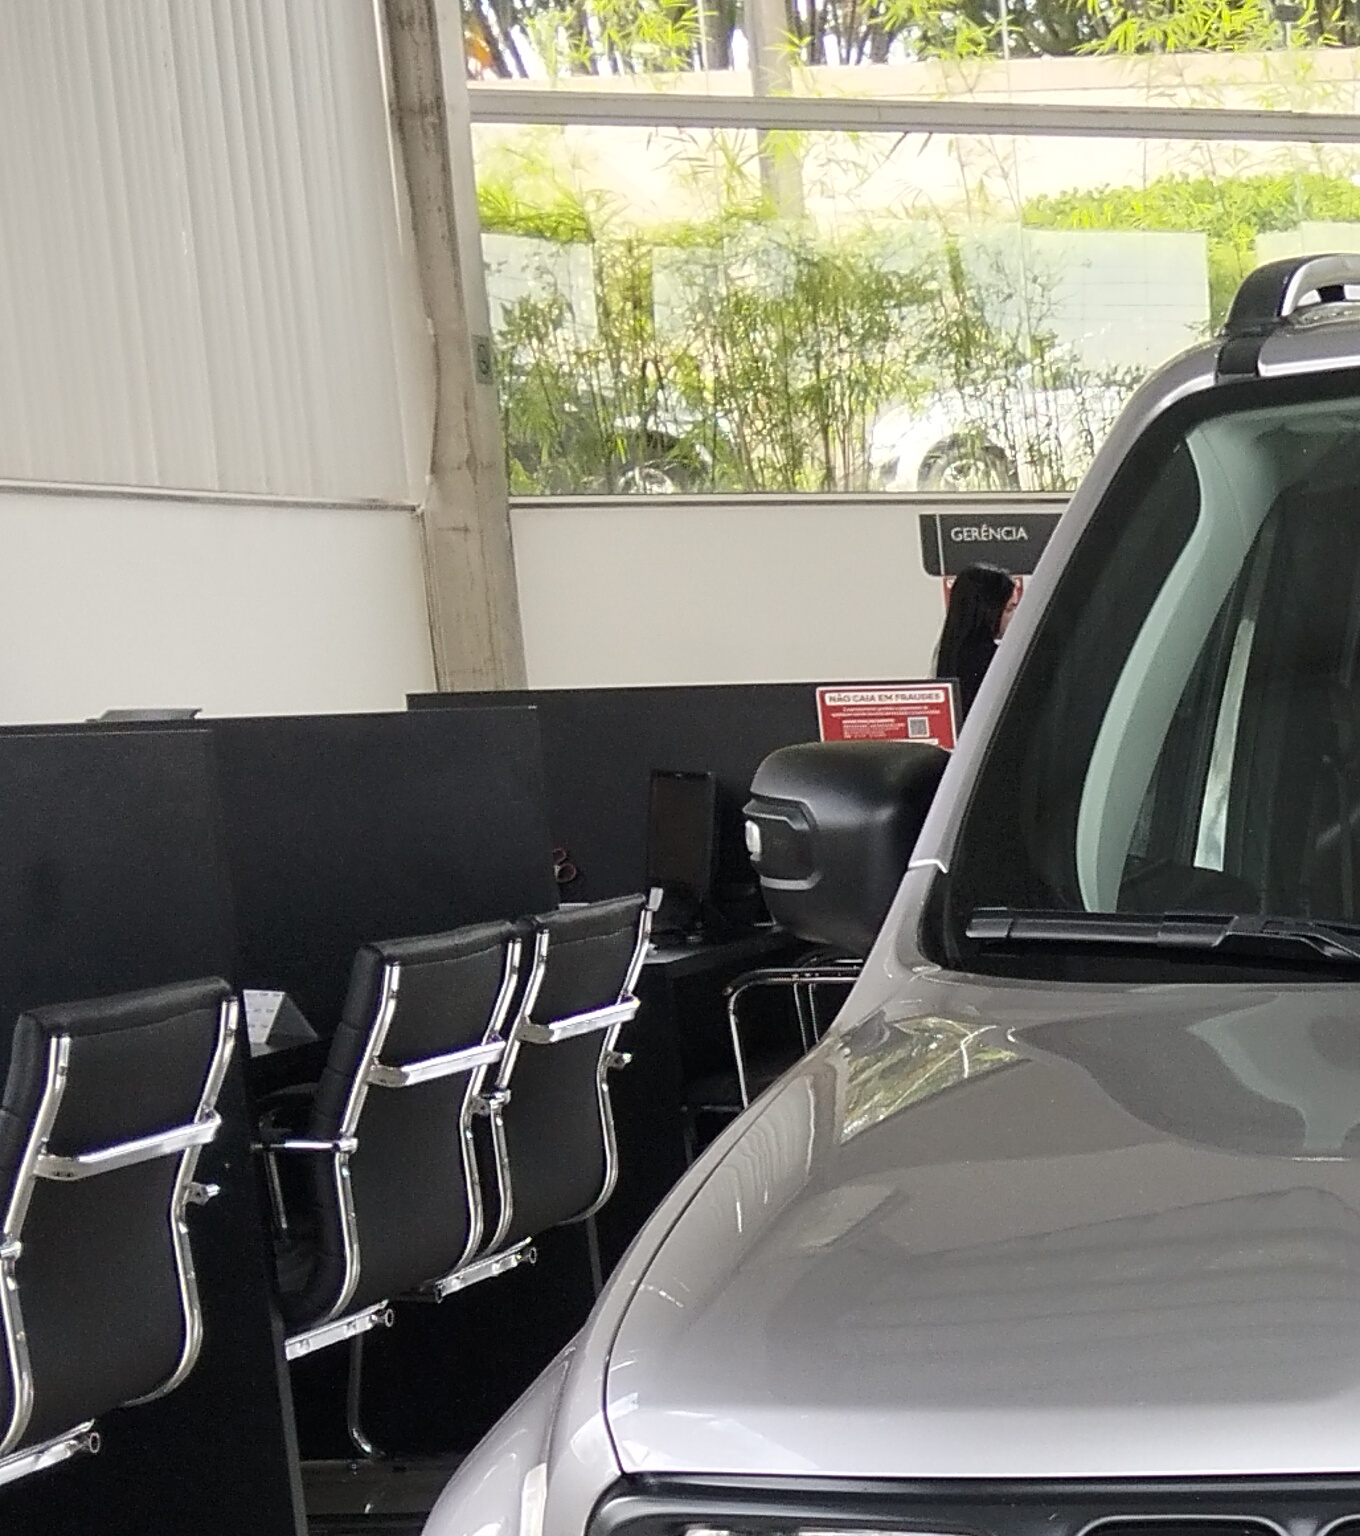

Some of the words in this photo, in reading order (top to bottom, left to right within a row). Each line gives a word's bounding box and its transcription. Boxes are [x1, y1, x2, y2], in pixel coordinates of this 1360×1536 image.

[950, 524, 1028, 542] GERÊNCIA
[828, 692, 851, 704] NÃO
[852, 692, 876, 703] CAIA
[878, 692, 894, 702] EM
[895, 691, 941, 702] FRAUDES
